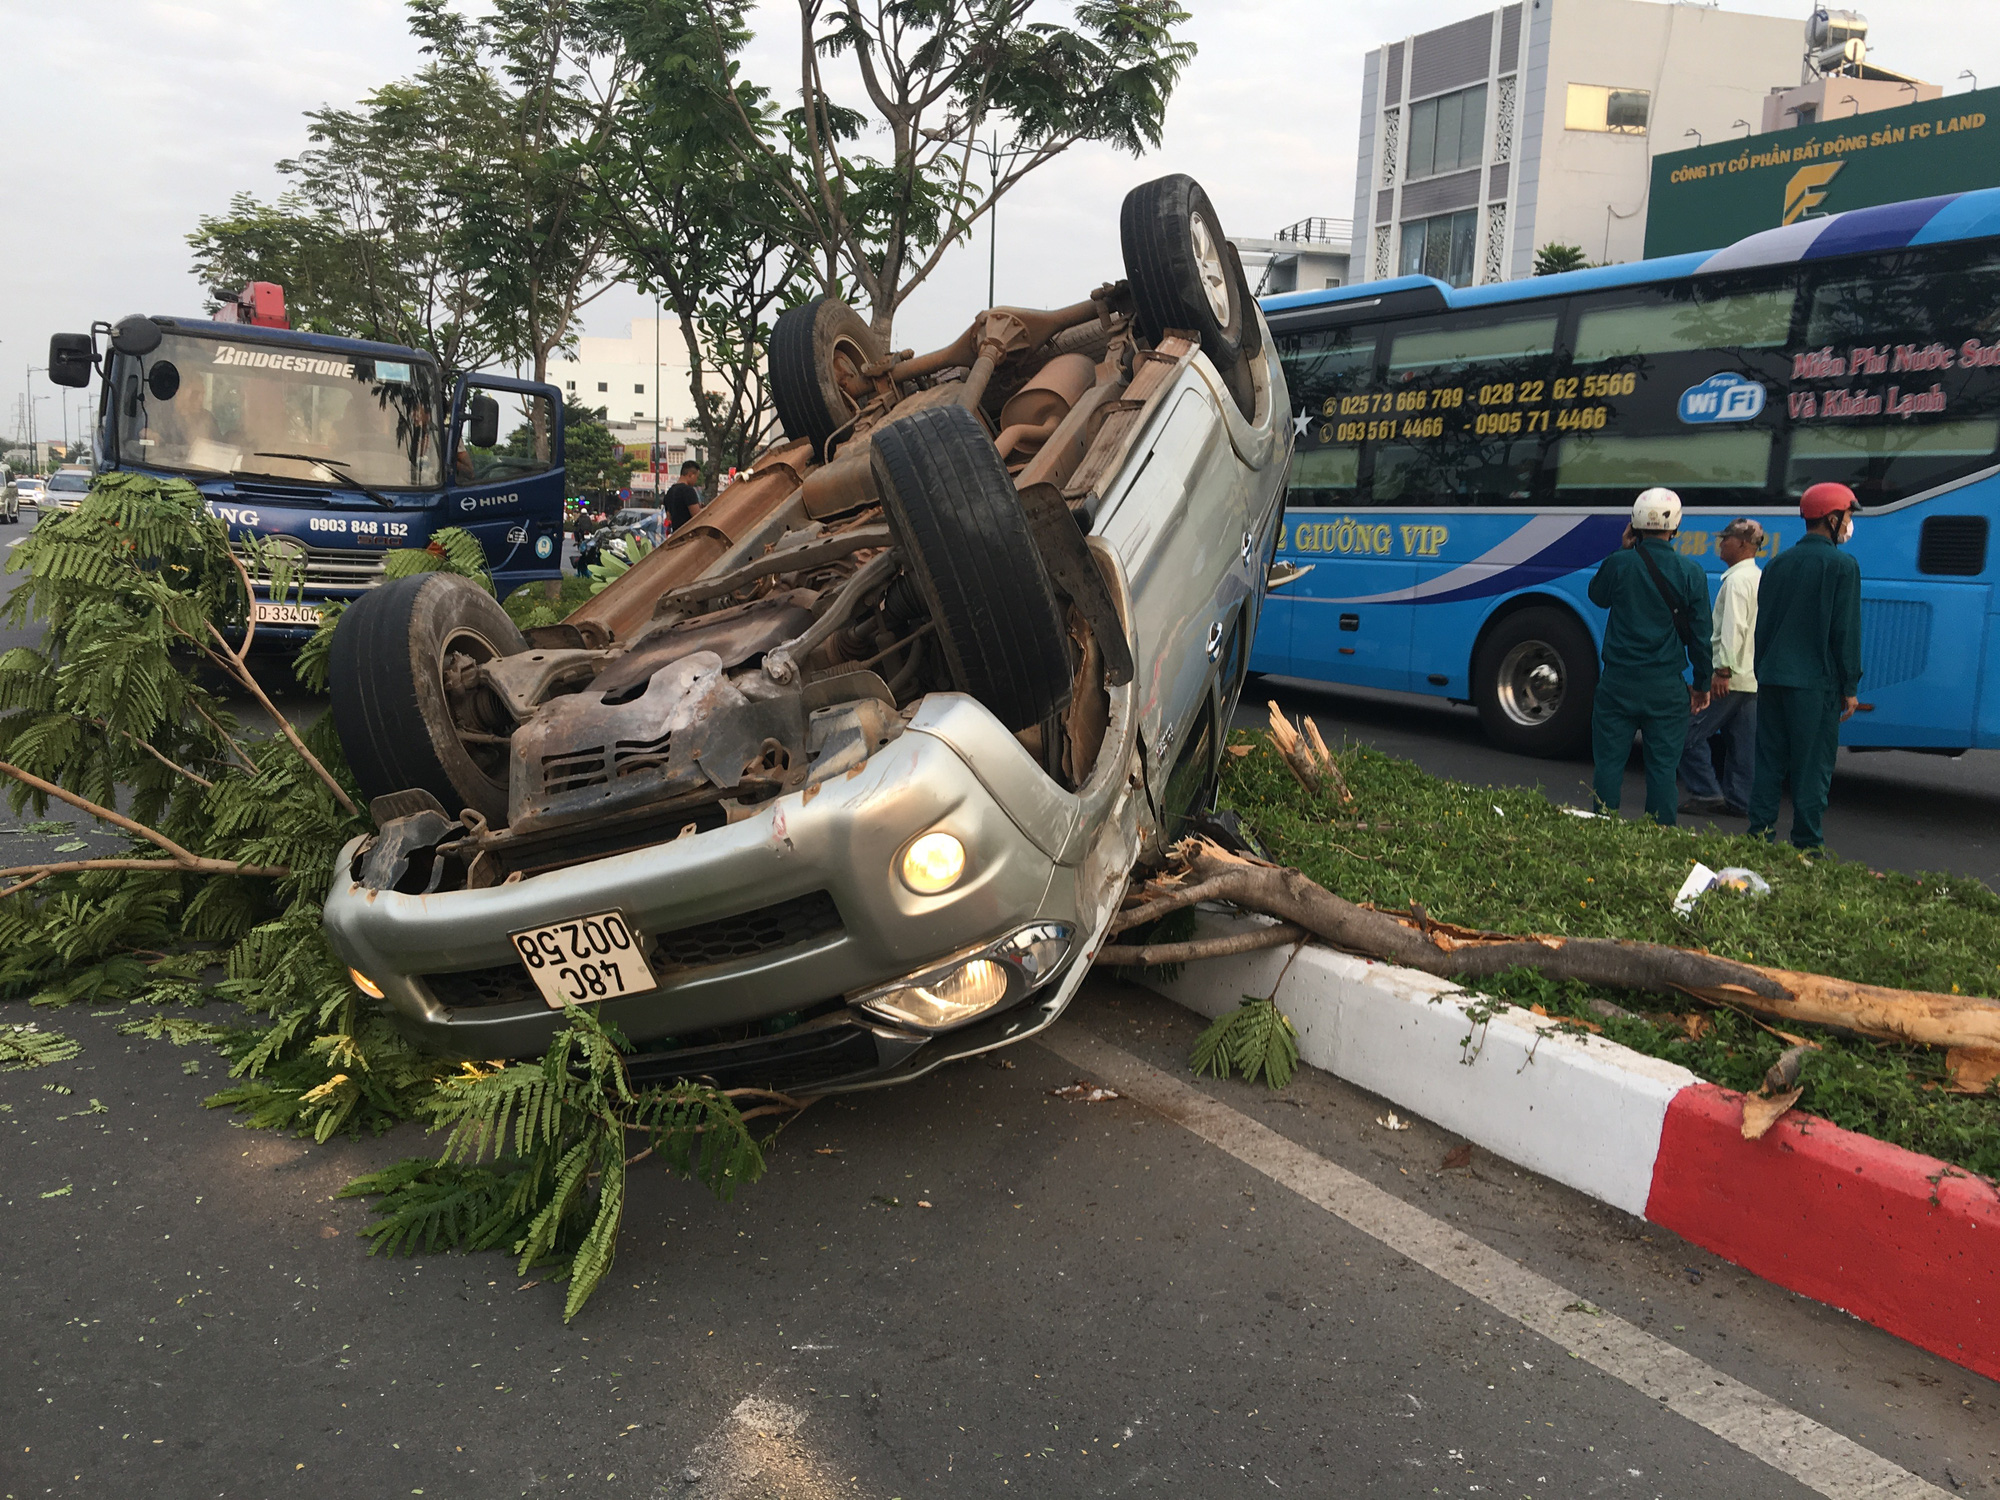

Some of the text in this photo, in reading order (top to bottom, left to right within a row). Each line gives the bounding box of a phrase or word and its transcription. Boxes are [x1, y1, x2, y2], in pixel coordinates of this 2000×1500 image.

[1670, 113, 1986, 184] CÔNG TY CỔ PHẦN BẤT ĐỘNG SẢN FC LAND
[212, 346, 355, 378] BRIDGESTONE
[1847, 344, 1892, 375] Phí
[1890, 342, 1956, 372] Nước
[1395, 390, 1428, 412] 666
[1431, 387, 1464, 410] 789
[1478, 382, 1515, 406] 028
[1517, 380, 1545, 403] 22
[1552, 377, 1579, 400] 62
[1581, 372, 1637, 398] 5566
[1885, 384, 1947, 419] Lạnh
[1401, 416, 1444, 438] 4466
[1475, 411, 1523, 435] 0905
[1526, 409, 1550, 432] 71
[1555, 406, 1607, 431] 4466
[480, 493, 518, 507] HINO
[310, 518, 408, 536] 0903 848 152
[1295, 516, 1394, 554] GIƯỜNG
[1399, 525, 1449, 557] VIP
[517, 916, 630, 968] 002.58
[559, 960, 625, 999] 48C
